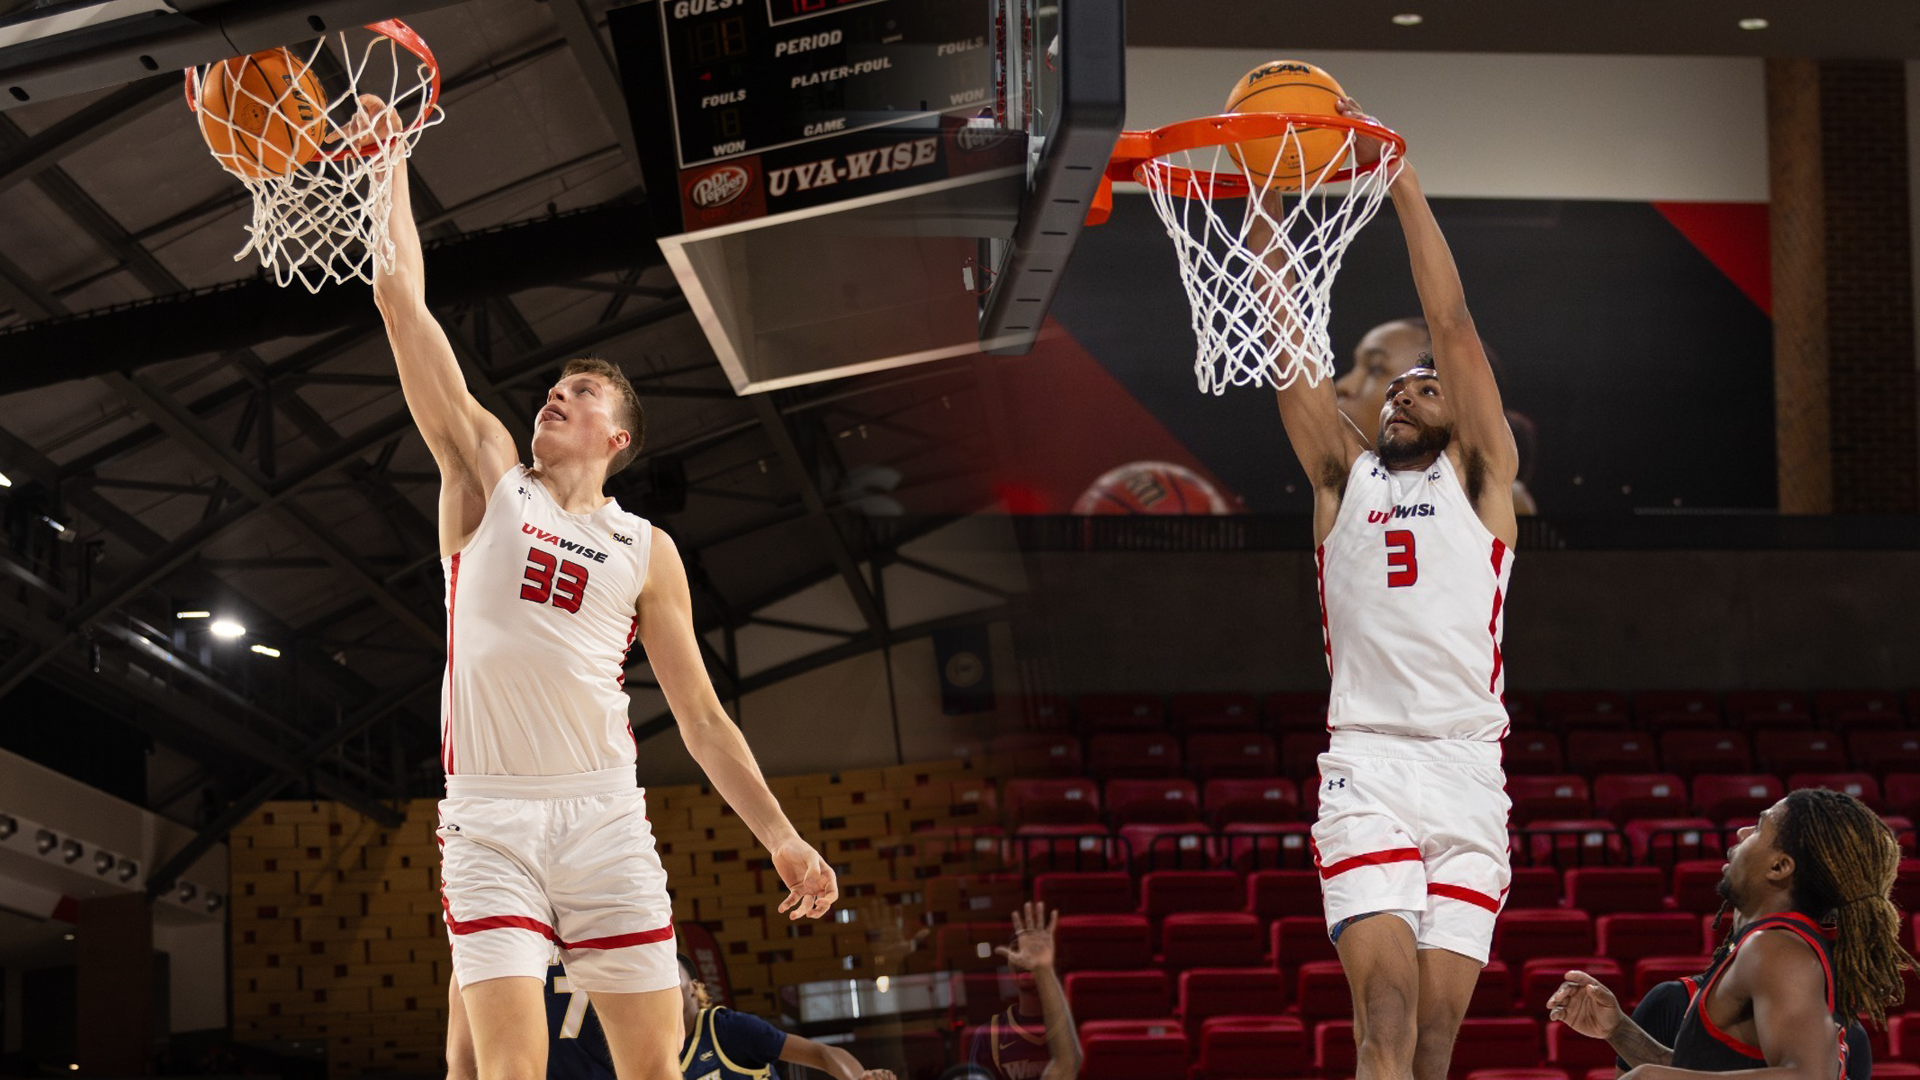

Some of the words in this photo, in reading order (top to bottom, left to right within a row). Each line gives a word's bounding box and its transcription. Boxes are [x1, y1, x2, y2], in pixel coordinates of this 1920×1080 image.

[673, 0, 745, 20] GUES
[774, 29, 843, 58] PERIOD
[937, 36, 985, 56] FOULS
[790, 56, 892, 89] PLAYER-FOUL
[701, 88, 747, 109] FOULS
[949, 88, 985, 106] WON
[803, 117, 846, 137] GAME
[712, 139, 746, 157] WON
[768, 136, 938, 198] UVA-WISE
[698, 173, 743, 206] Pepper
[711, 171, 731, 190] Dr
[522, 522, 608, 564] UVAWISE
[612, 533, 633, 546] SAC
[1385, 529, 1418, 588] 3
[520, 546, 589, 614] 33
